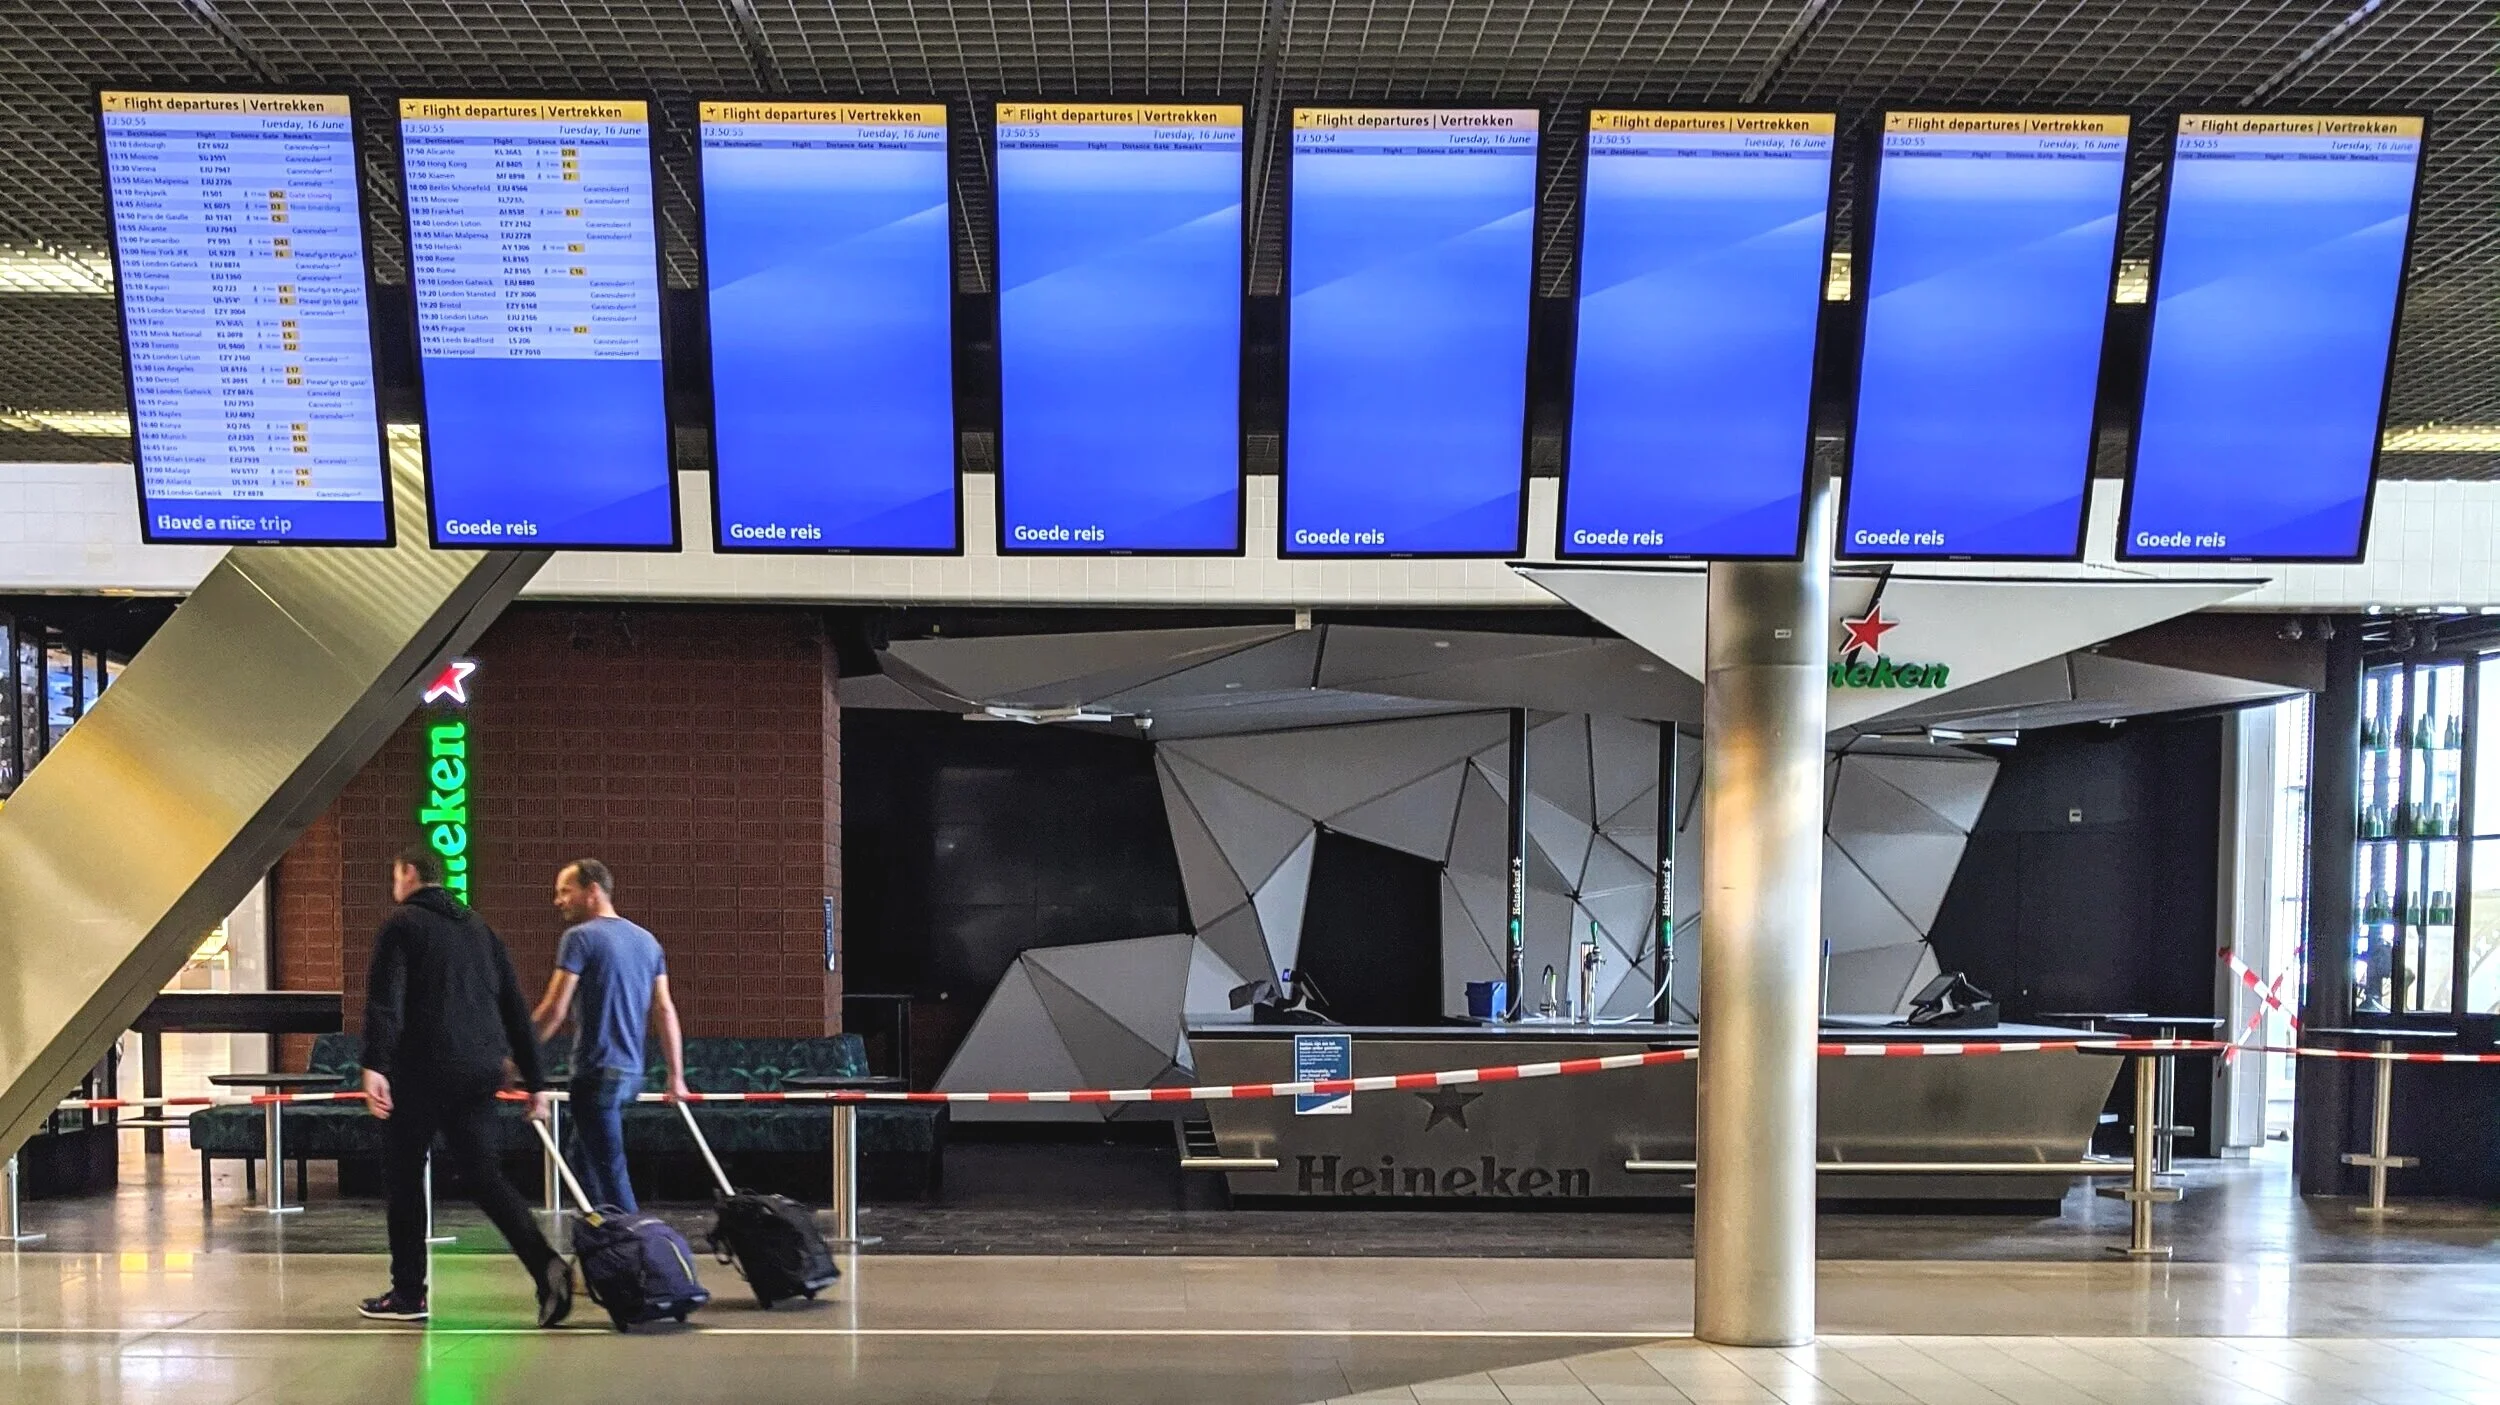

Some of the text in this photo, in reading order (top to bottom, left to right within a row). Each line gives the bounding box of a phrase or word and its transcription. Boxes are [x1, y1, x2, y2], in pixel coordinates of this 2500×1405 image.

[125, 97, 324, 112] Flight departures Vertrekken
[423, 104, 622, 118] Flight departures Vertrekken
[723, 108, 921, 122] Flight departures Vertrekken
[1020, 109, 1217, 123] Flight departures Vertrekken
[1316, 115, 1513, 128] Flight departures Vertrekken
[262, 120, 344, 130] Tuesday, 16 June
[405, 124, 444, 133] 13:50:55
[1613, 116, 1809, 130] Flight departures Vertrekken
[1908, 119, 2104, 133] Flight departures Vertrekken
[2201, 120, 2397, 135] Flight departures Vertrekken
[559, 125, 641, 136] Tuesday, 16 June
[704, 127, 743, 137] 13:50:55
[858, 128, 939, 139] Tuesday, 16 June
[1000, 129, 1040, 138] 13:50:55
[1154, 130, 1235, 141] Tuesday, 16 June
[1449, 135, 1531, 145] Tuesday, 16 June
[1592, 135, 1631, 145] 13:50:55
[1745, 137, 1826, 148] Tuesday, 16 June
[1886, 137, 1925, 146] 13:50:55
[2039, 139, 2079, 149] Tuesday,
[2097, 141, 2120, 149] June
[2179, 140, 2218, 148] 13:50:55
[2332, 142, 2372, 152] Tuesday,
[2390, 143, 2413, 151] June
[427, 161, 446, 169] Hong
[205, 518, 216, 529] a
[220, 516, 256, 530] nice
[260, 516, 292, 534] trip
[446, 520, 537, 535] Goede reis
[730, 524, 821, 539] Goede reis
[1014, 525, 1104, 541] Goede reis
[1295, 529, 1385, 544] Goede reis
[1574, 529, 1664, 545] Goede reis
[1855, 530, 1944, 545] Goede reis
[2136, 532, 2226, 547] Goede reis
[1512, 871, 1521, 915] Heineken
[1662, 872, 1670, 916] Heineken
[1296, 1155, 1590, 1197] Heineken
